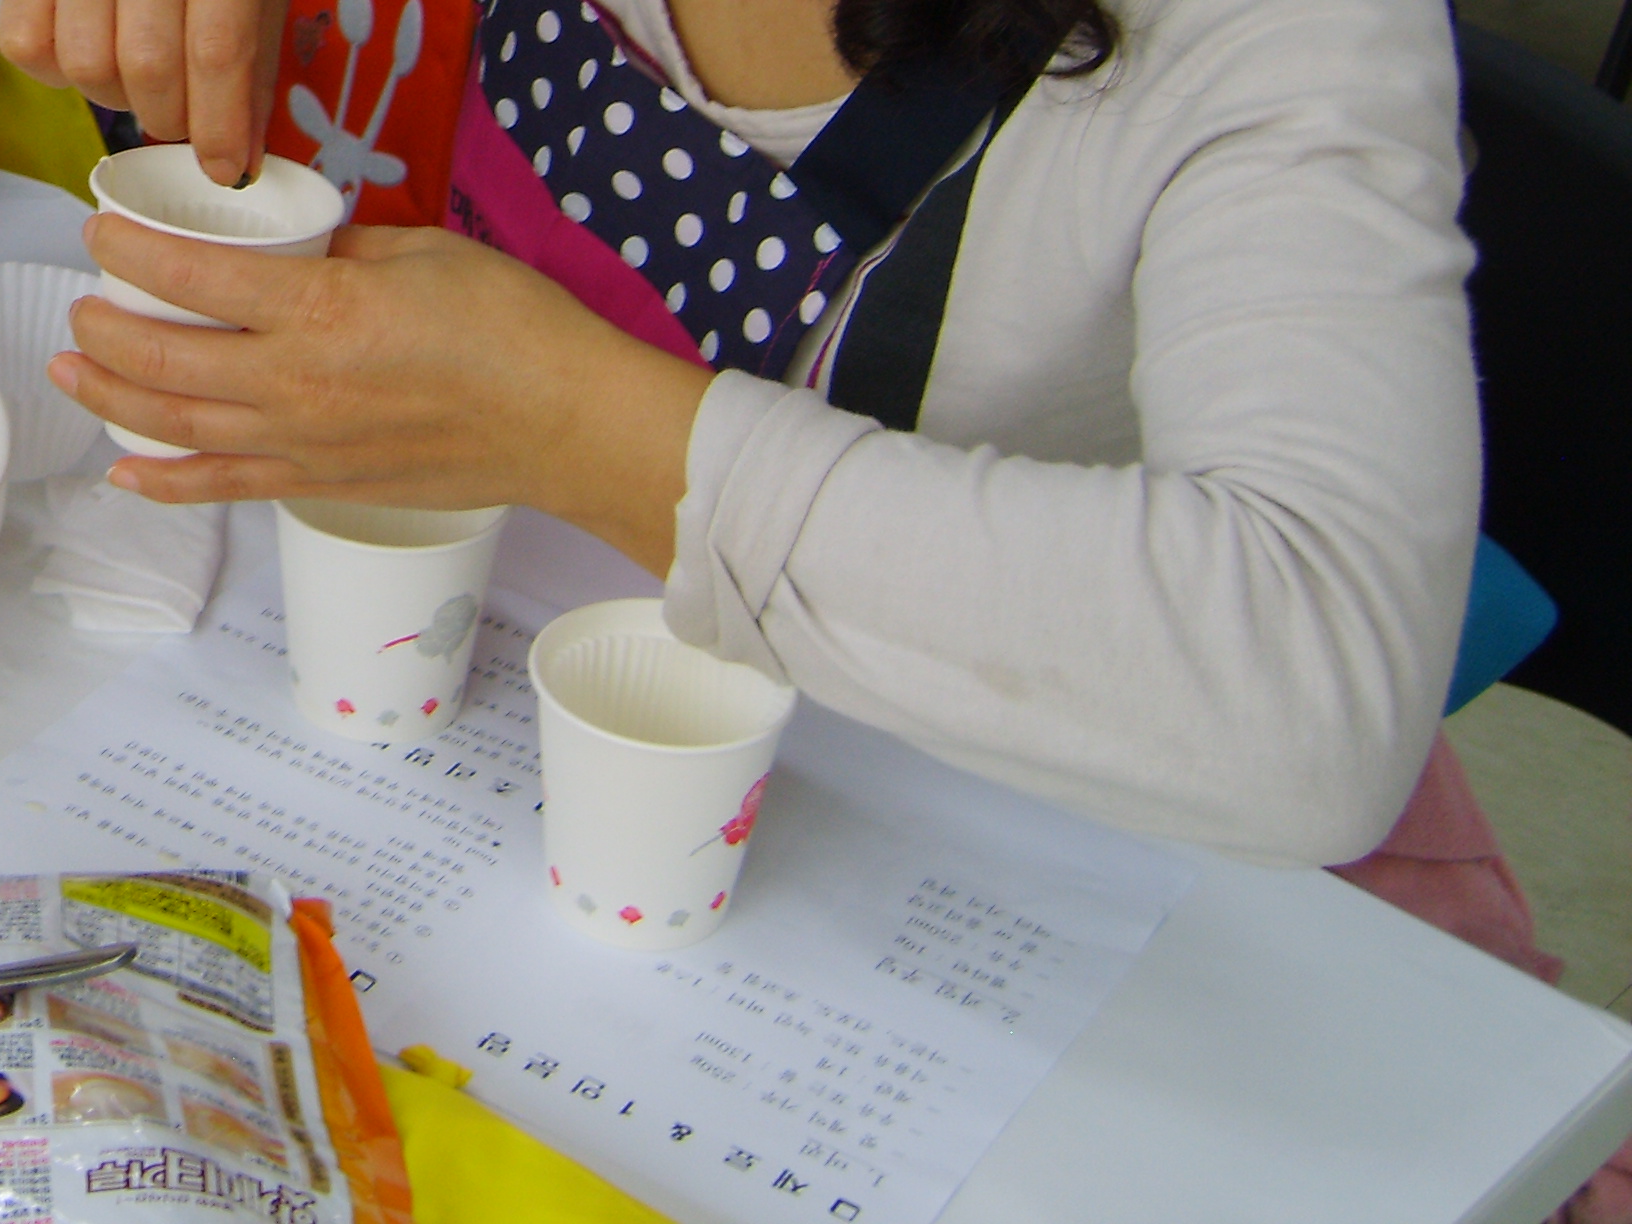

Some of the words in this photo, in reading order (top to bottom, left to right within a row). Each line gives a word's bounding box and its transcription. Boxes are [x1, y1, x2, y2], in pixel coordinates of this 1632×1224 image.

[893, 934, 927, 955] 10g
[905, 915, 963, 945] 250ml
[694, 1031, 753, 1064] 130ml
[689, 1054, 737, 1083] 250g
